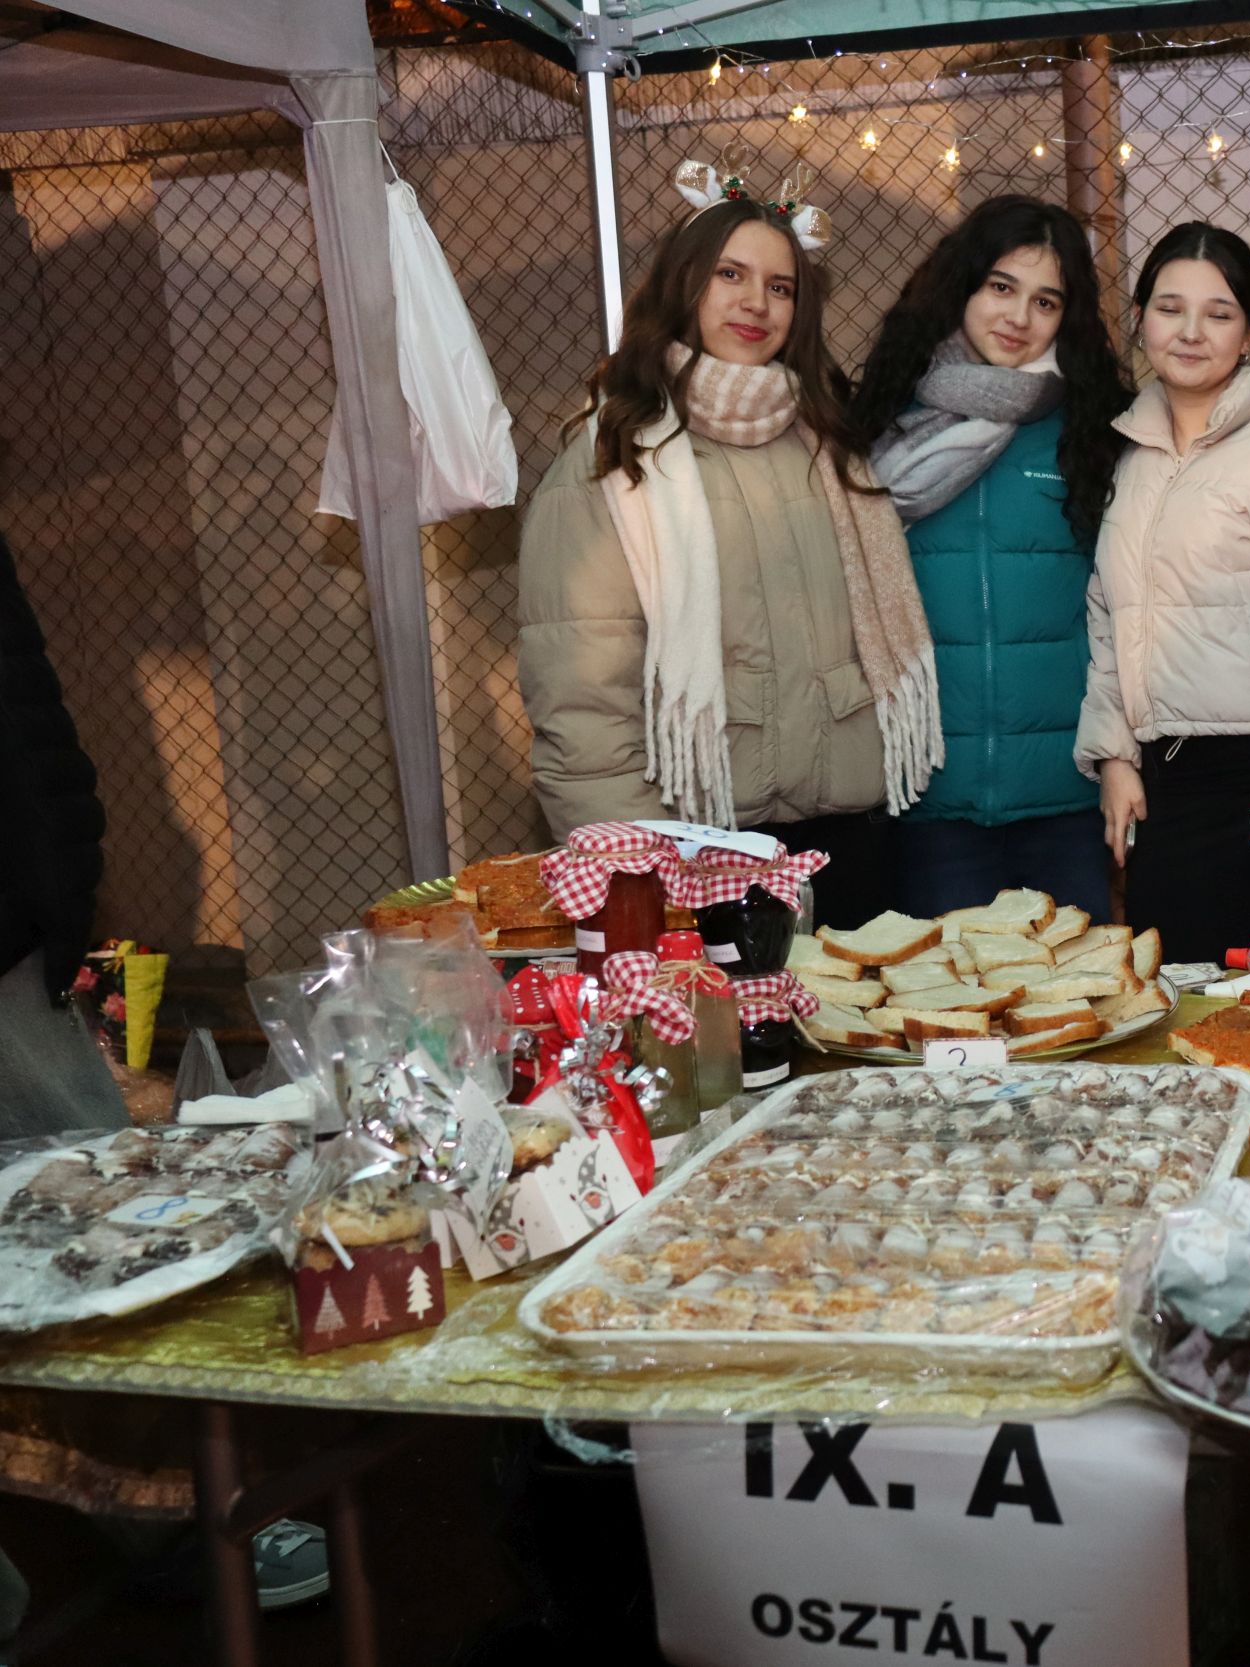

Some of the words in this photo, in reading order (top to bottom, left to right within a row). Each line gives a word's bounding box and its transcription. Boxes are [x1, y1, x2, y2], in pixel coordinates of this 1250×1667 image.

[135, 1196, 189, 1220] 8
[744, 1421, 915, 1511] IX.
[965, 1422, 1065, 1526] A
[751, 1593, 1056, 1666] OSZTÁLY
